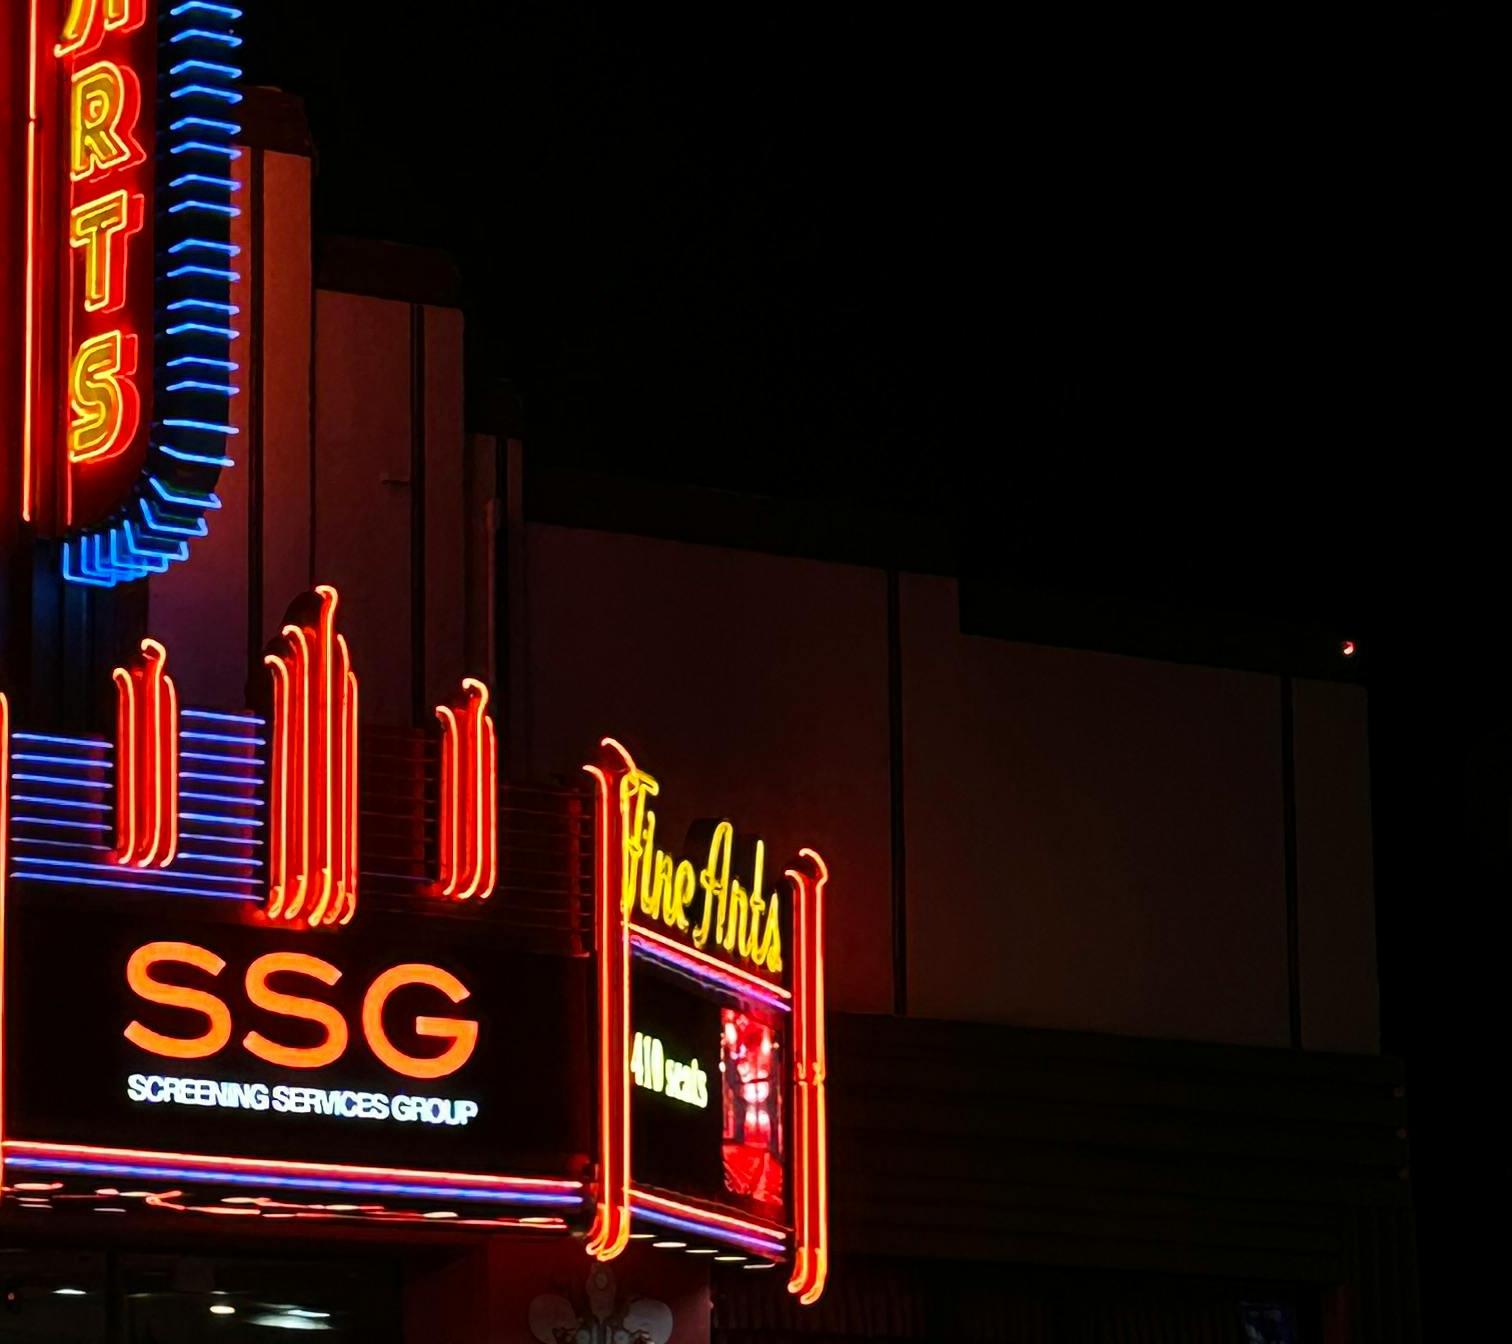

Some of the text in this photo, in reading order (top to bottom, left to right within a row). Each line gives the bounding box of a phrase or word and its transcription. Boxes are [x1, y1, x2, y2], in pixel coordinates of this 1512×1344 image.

[619, 768, 783, 973] Fine Arts
[123, 940, 480, 1080] SSG
[127, 1073, 480, 1126] SCREENING SERVICES GROUP
[630, 1031, 709, 1110] 410 seats
